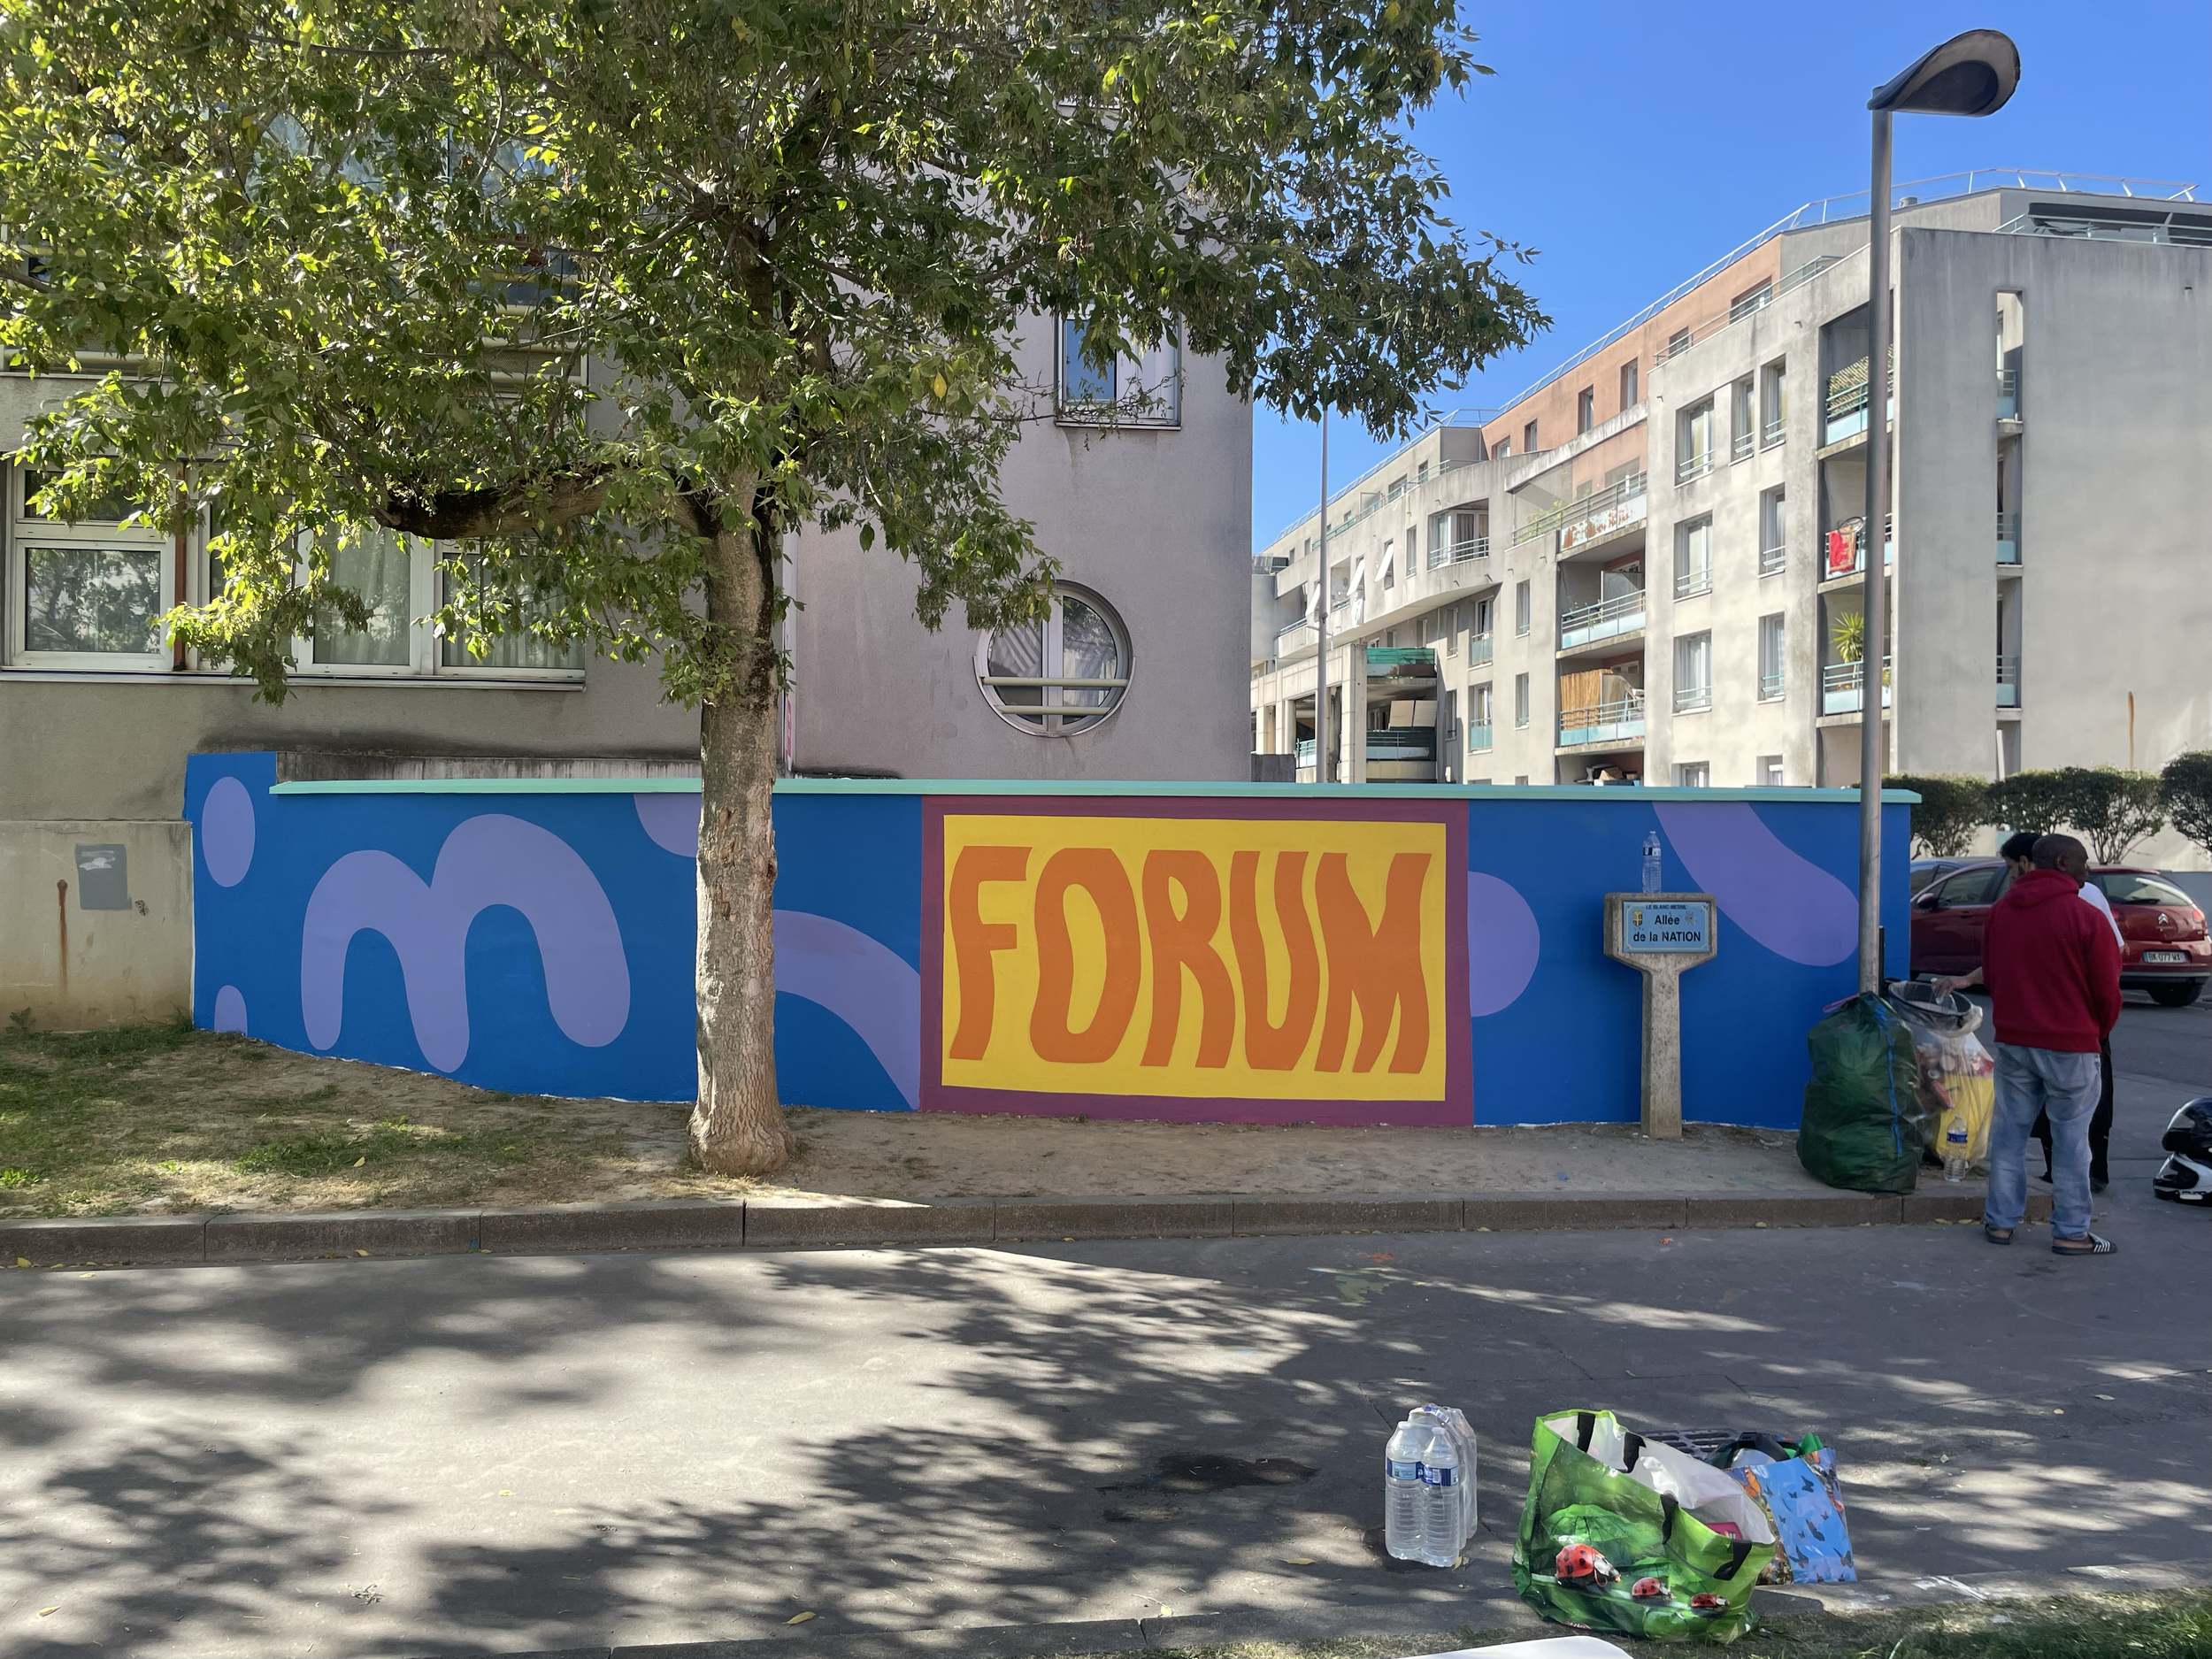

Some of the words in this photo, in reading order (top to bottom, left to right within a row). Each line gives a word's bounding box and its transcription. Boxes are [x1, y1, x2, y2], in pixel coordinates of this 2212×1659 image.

[1655, 913, 1680, 925] Allée
[1633, 932, 1646, 941] de
[1649, 932, 1658, 942] la
[1662, 932, 1701, 942] NATION
[949, 845, 1432, 1074] FORUM
